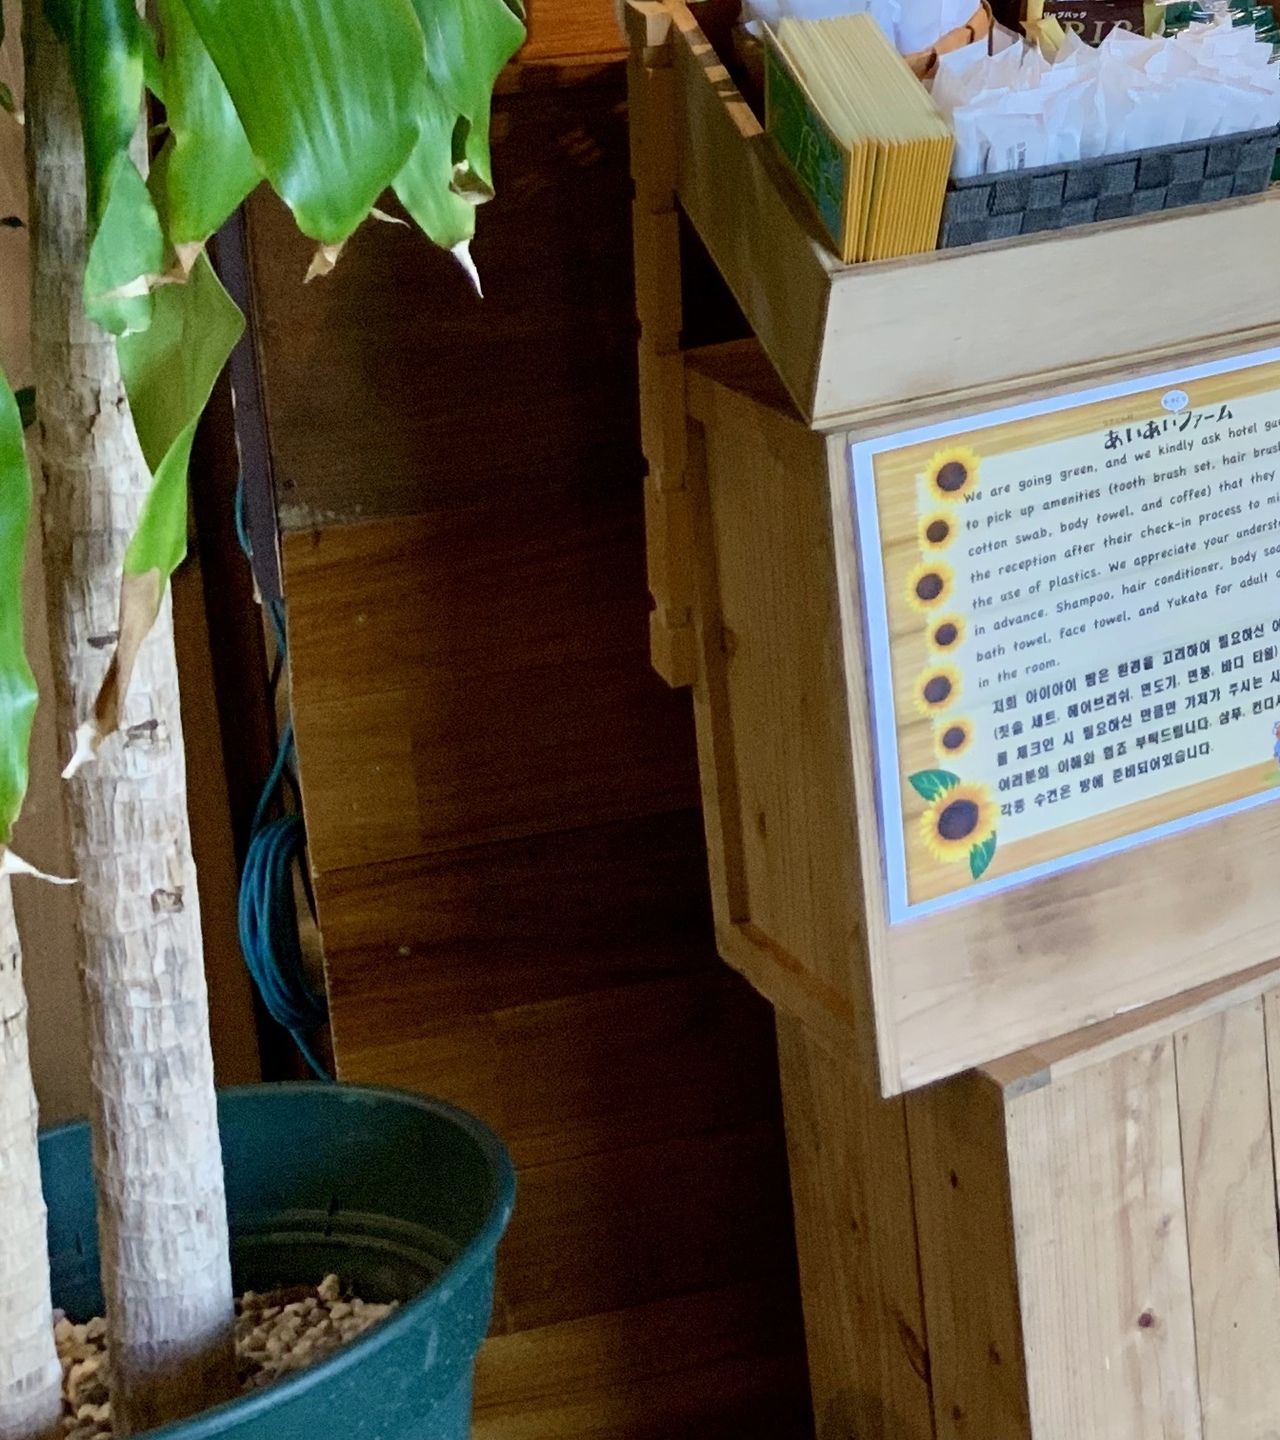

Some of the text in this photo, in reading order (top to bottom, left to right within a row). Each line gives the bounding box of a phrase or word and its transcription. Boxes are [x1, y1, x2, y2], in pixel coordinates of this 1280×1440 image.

[963, 491, 982, 504] We
[990, 484, 1010, 497] are
[1018, 474, 1052, 492] going
[1105, 453, 1127, 469] and
[1134, 450, 1151, 462] we
[1158, 439, 1194, 456] kindly
[1201, 432, 1222, 446] ask
[1228, 422, 1257, 439] hotel
[1104, 403, 1234, 450] あいあいファーム
[966, 519, 979, 531] to
[986, 509, 1012, 528] pick
[1020, 505, 1035, 518] up
[1042, 488, 1101, 511] amenities
[1108, 475, 1146, 495] (tooth
[1153, 465, 1187, 483] brush
[1222, 451, 1247, 466] hair
[968, 539, 1008, 557] cotton
[1060, 517, 1089, 533] body
[1141, 496, 1163, 512] and
[1170, 484, 1212, 505] coffee)
[1218, 477, 1243, 493] that
[1250, 470, 1275, 485] they
